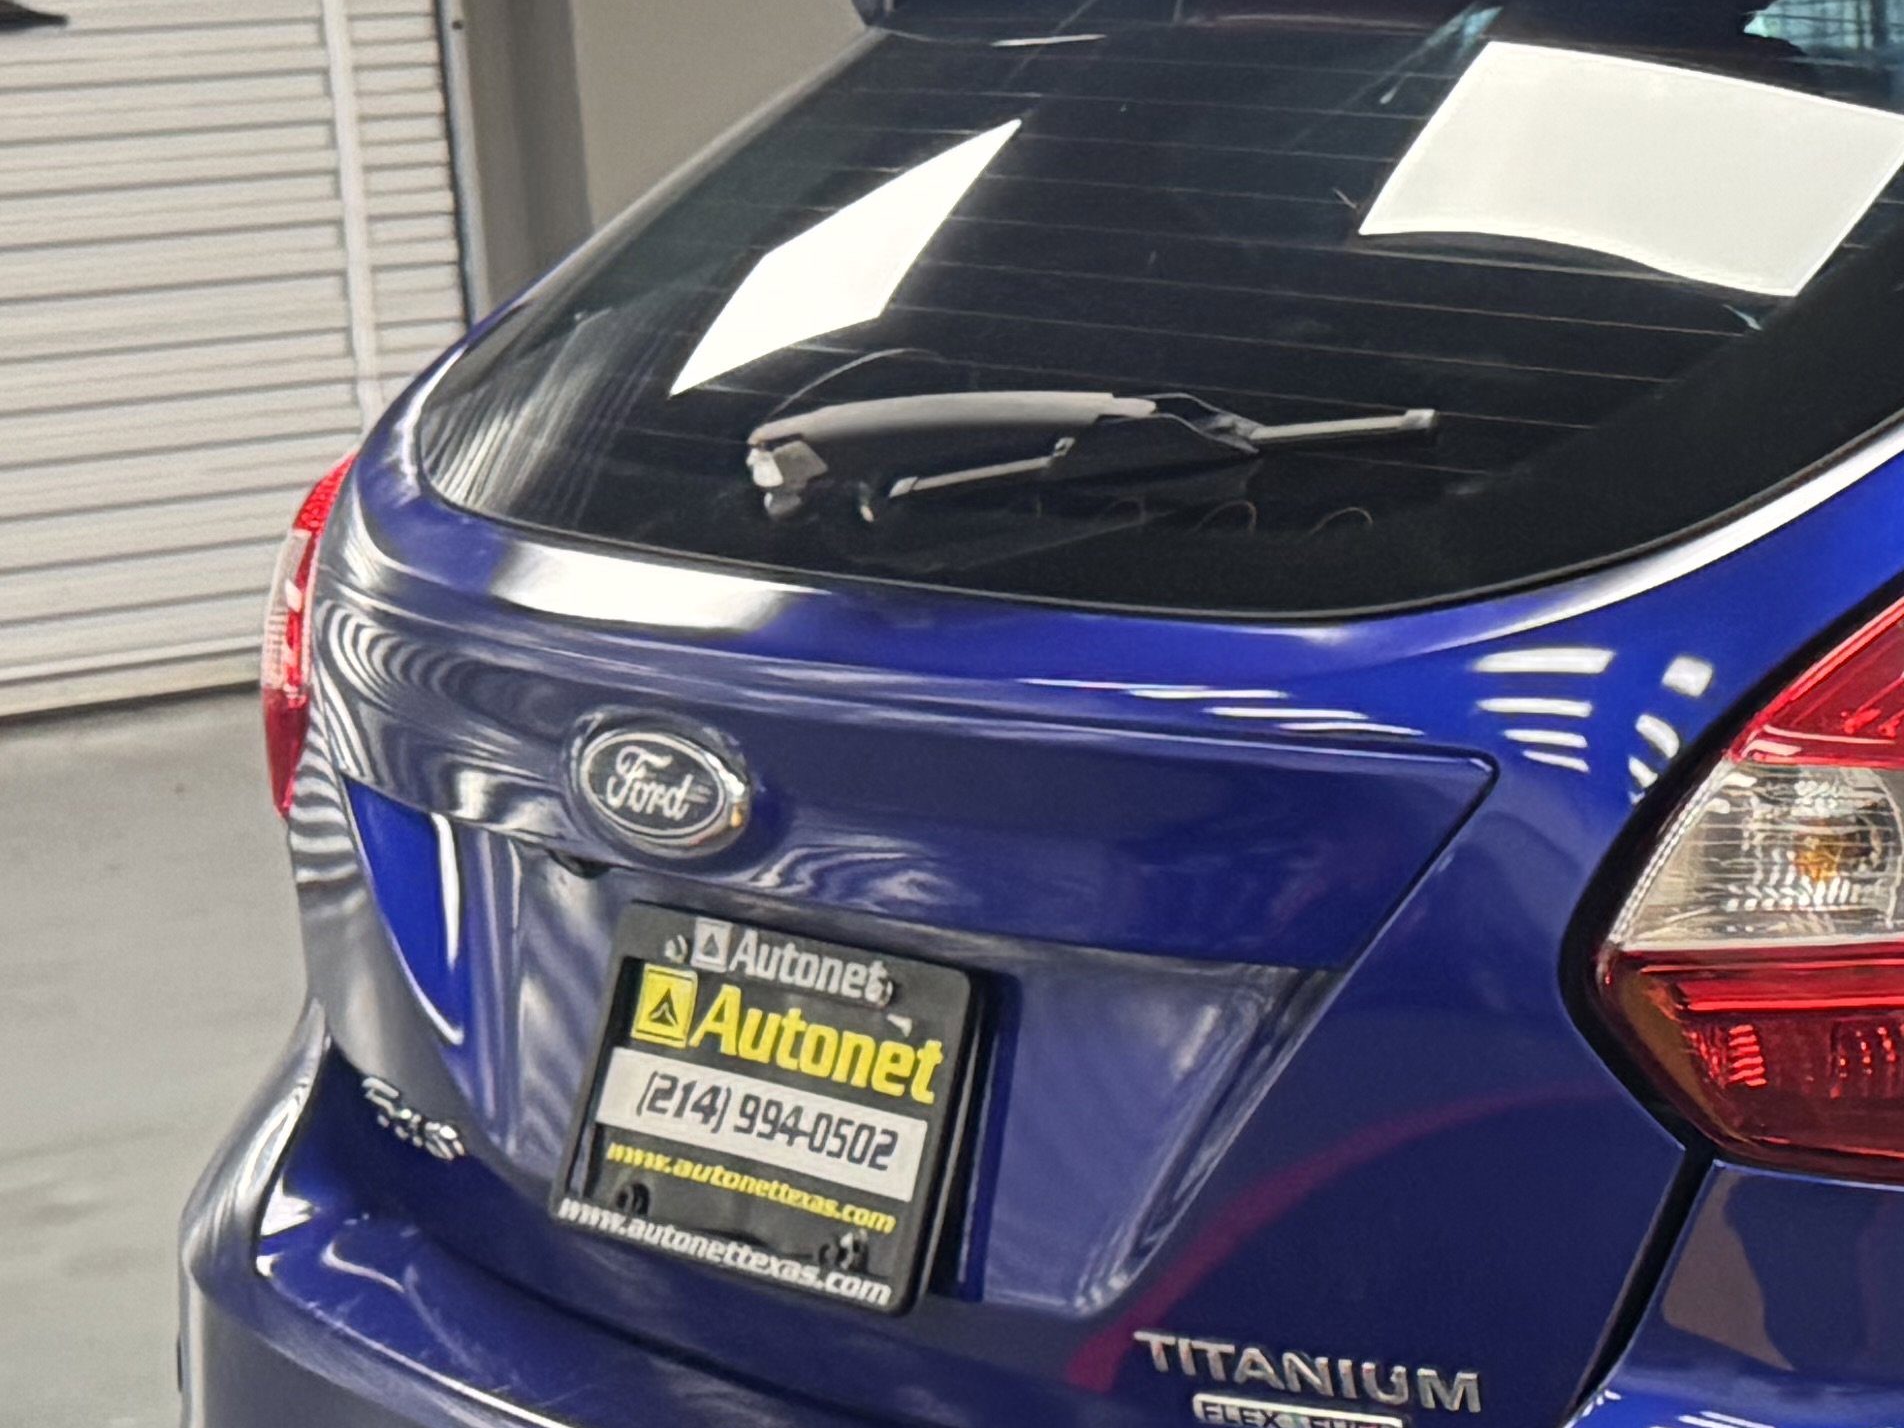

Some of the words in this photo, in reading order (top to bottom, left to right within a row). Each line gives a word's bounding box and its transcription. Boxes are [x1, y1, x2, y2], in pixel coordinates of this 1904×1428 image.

[606, 745, 694, 821] Ford
[729, 929, 887, 1004] Autonet
[689, 984, 943, 1104] Autonet
[636, 1071, 731, 1134] (214)
[734, 1093, 898, 1171] 994-0502
[606, 1142, 896, 1234] www.autonettexas.com
[558, 1197, 892, 1306] www.autonettexas.com
[1133, 1330, 1482, 1413] TITANIUM
